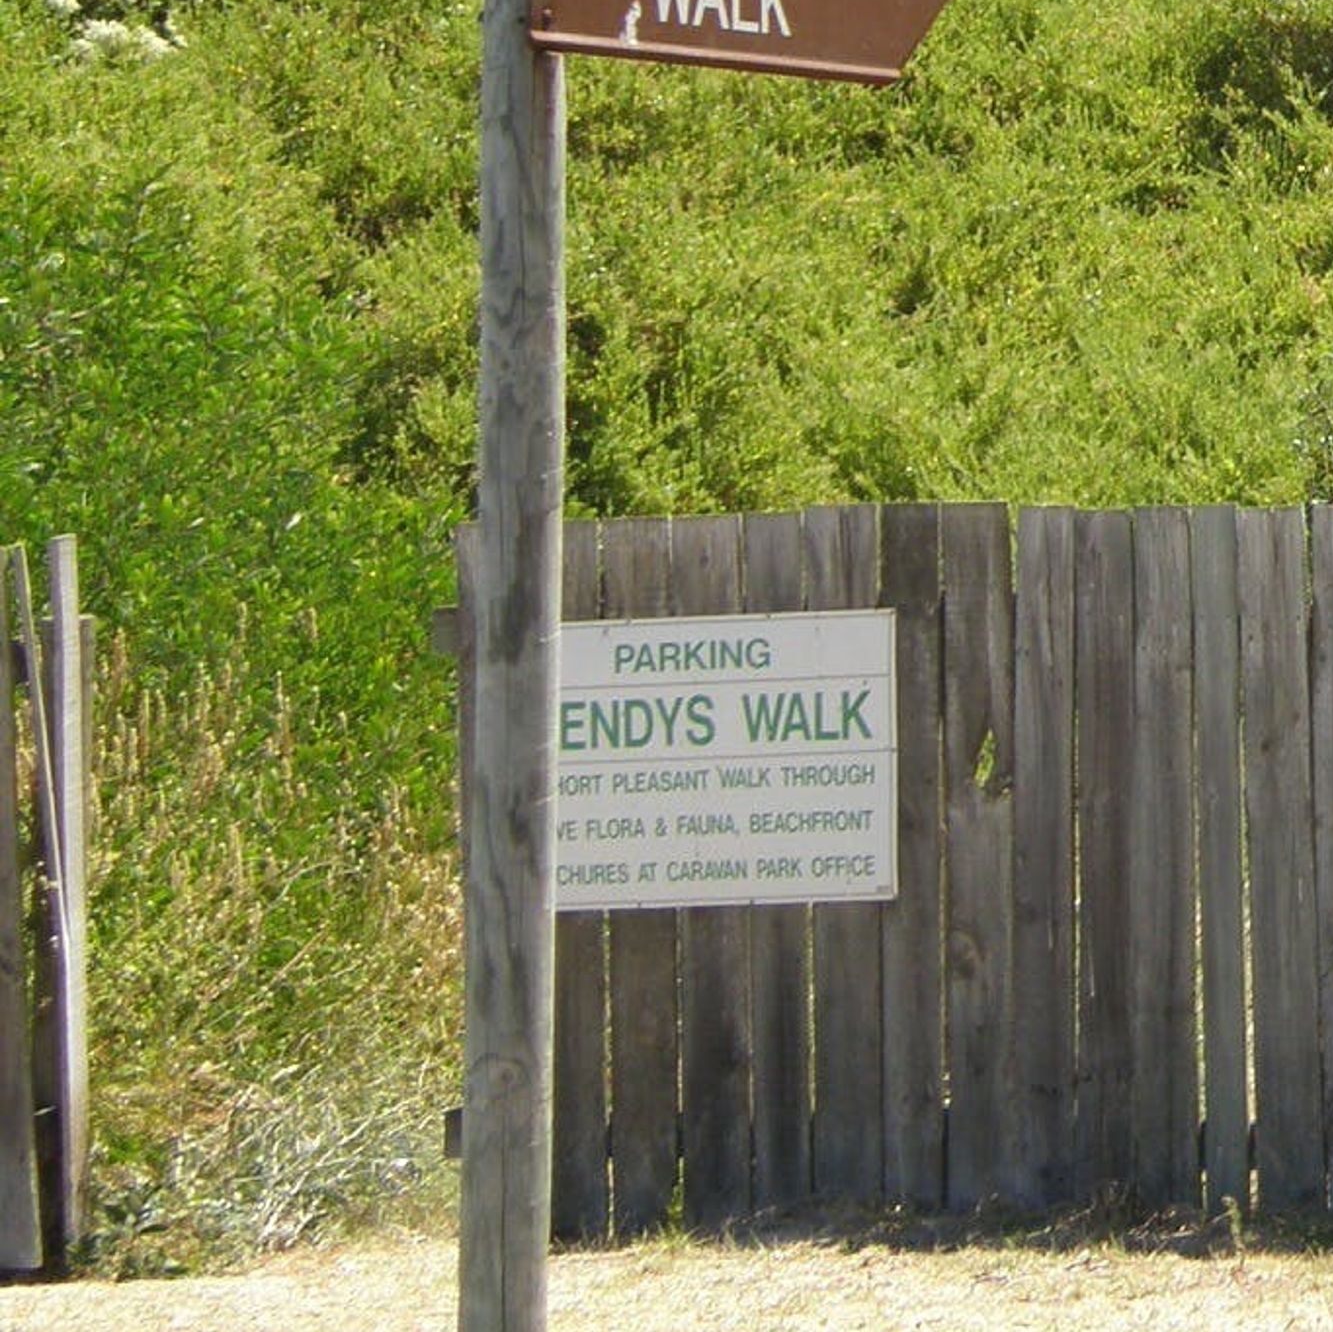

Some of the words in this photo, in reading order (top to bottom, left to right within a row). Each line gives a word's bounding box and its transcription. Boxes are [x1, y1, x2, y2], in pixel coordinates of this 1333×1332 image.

[614, 638, 772, 674] PARKING
[559, 693, 716, 751] ENDYS
[742, 688, 873, 743] WALK
[612, 768, 709, 794] PLEASANT
[719, 766, 772, 788] WALK
[781, 764, 875, 788] THROUGH
[586, 817, 645, 839] FLORA
[655, 816, 668, 837] &
[677, 813, 740, 836] FAUNA,
[750, 810, 873, 834] BEACHFRONT
[556, 863, 629, 886] CHURES
[638, 861, 659, 883] AT
[667, 858, 748, 882] CARAVAN
[757, 857, 802, 878] PARK
[811, 854, 876, 877] OFFICE
